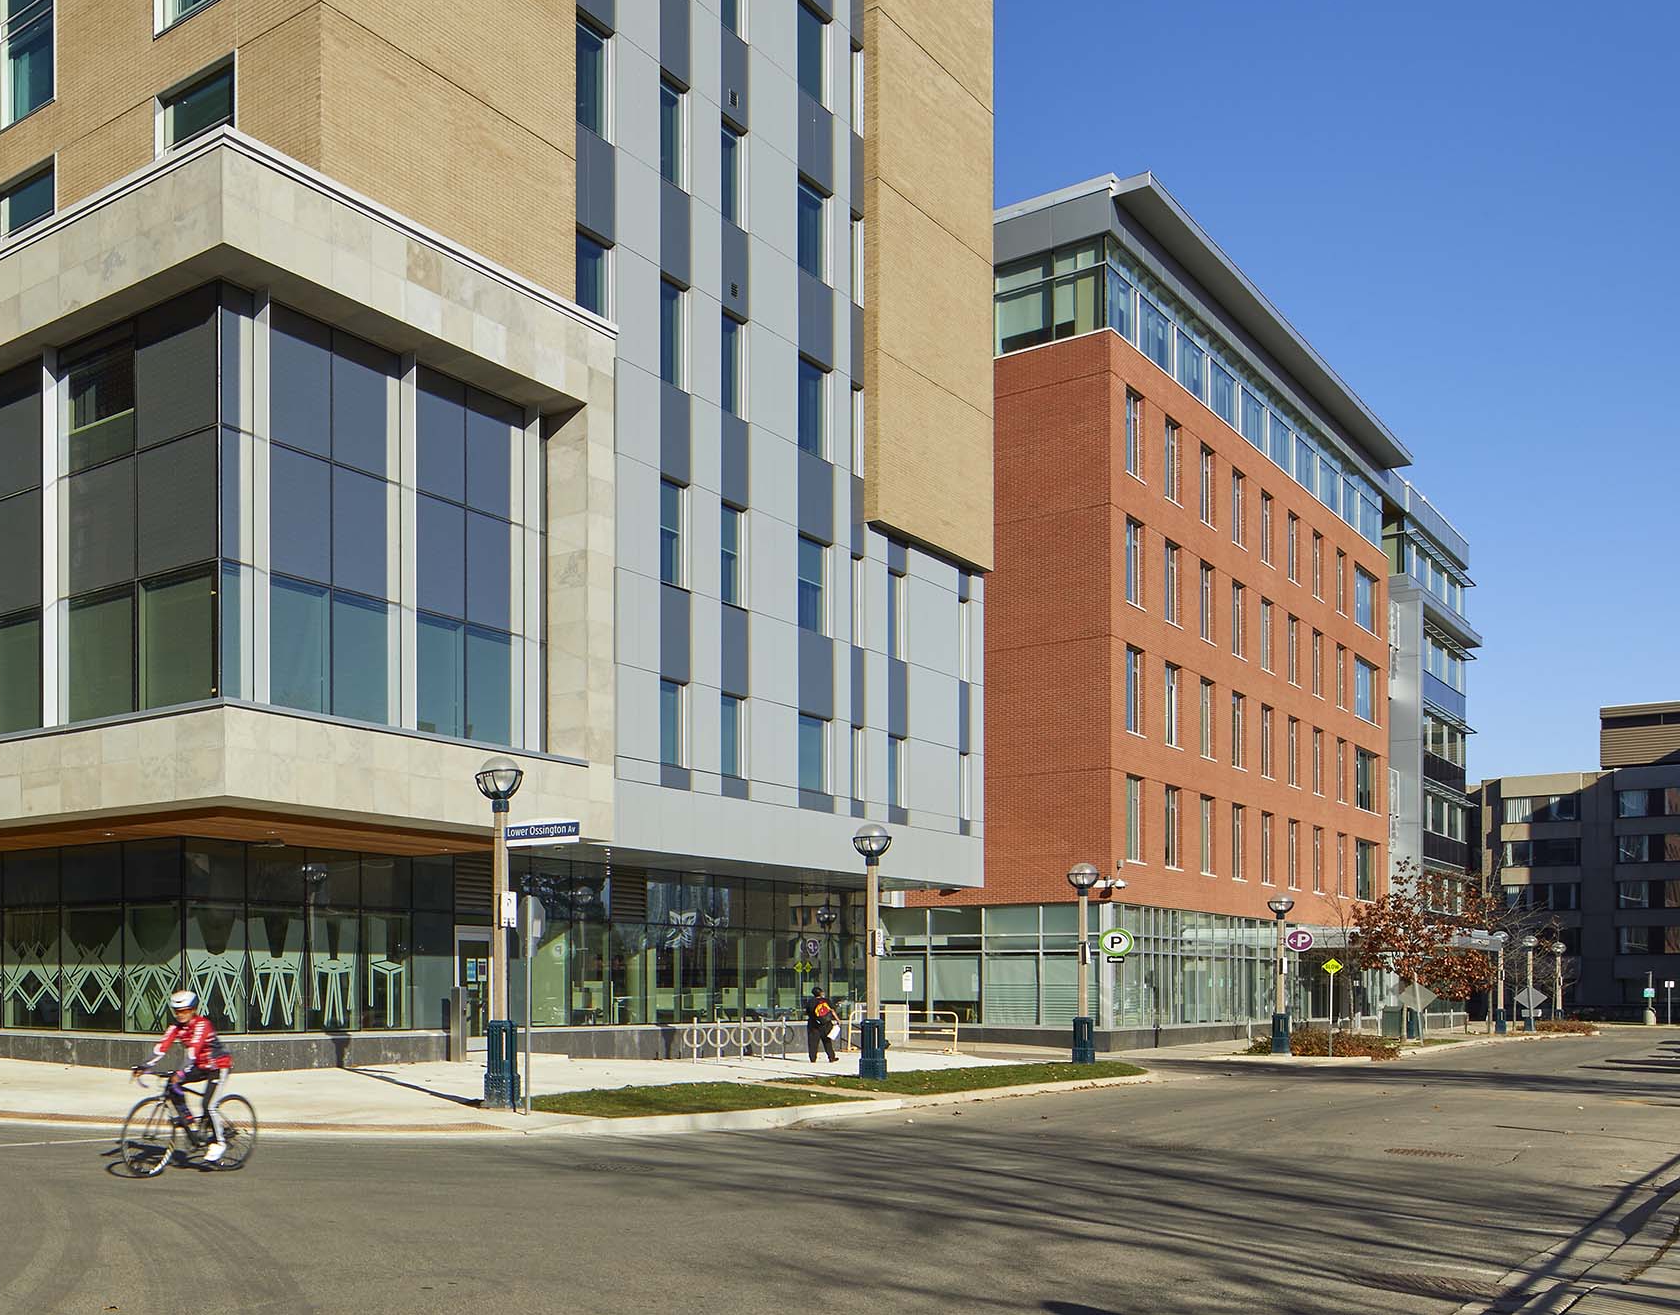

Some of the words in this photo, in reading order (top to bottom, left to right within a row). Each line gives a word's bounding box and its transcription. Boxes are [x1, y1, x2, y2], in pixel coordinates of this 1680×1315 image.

[507, 827, 528, 837] Lower
[529, 825, 567, 837] Ossington
[567, 825, 576, 833] Av
[1110, 936, 1123, 949] P
[1297, 933, 1311, 948] P
